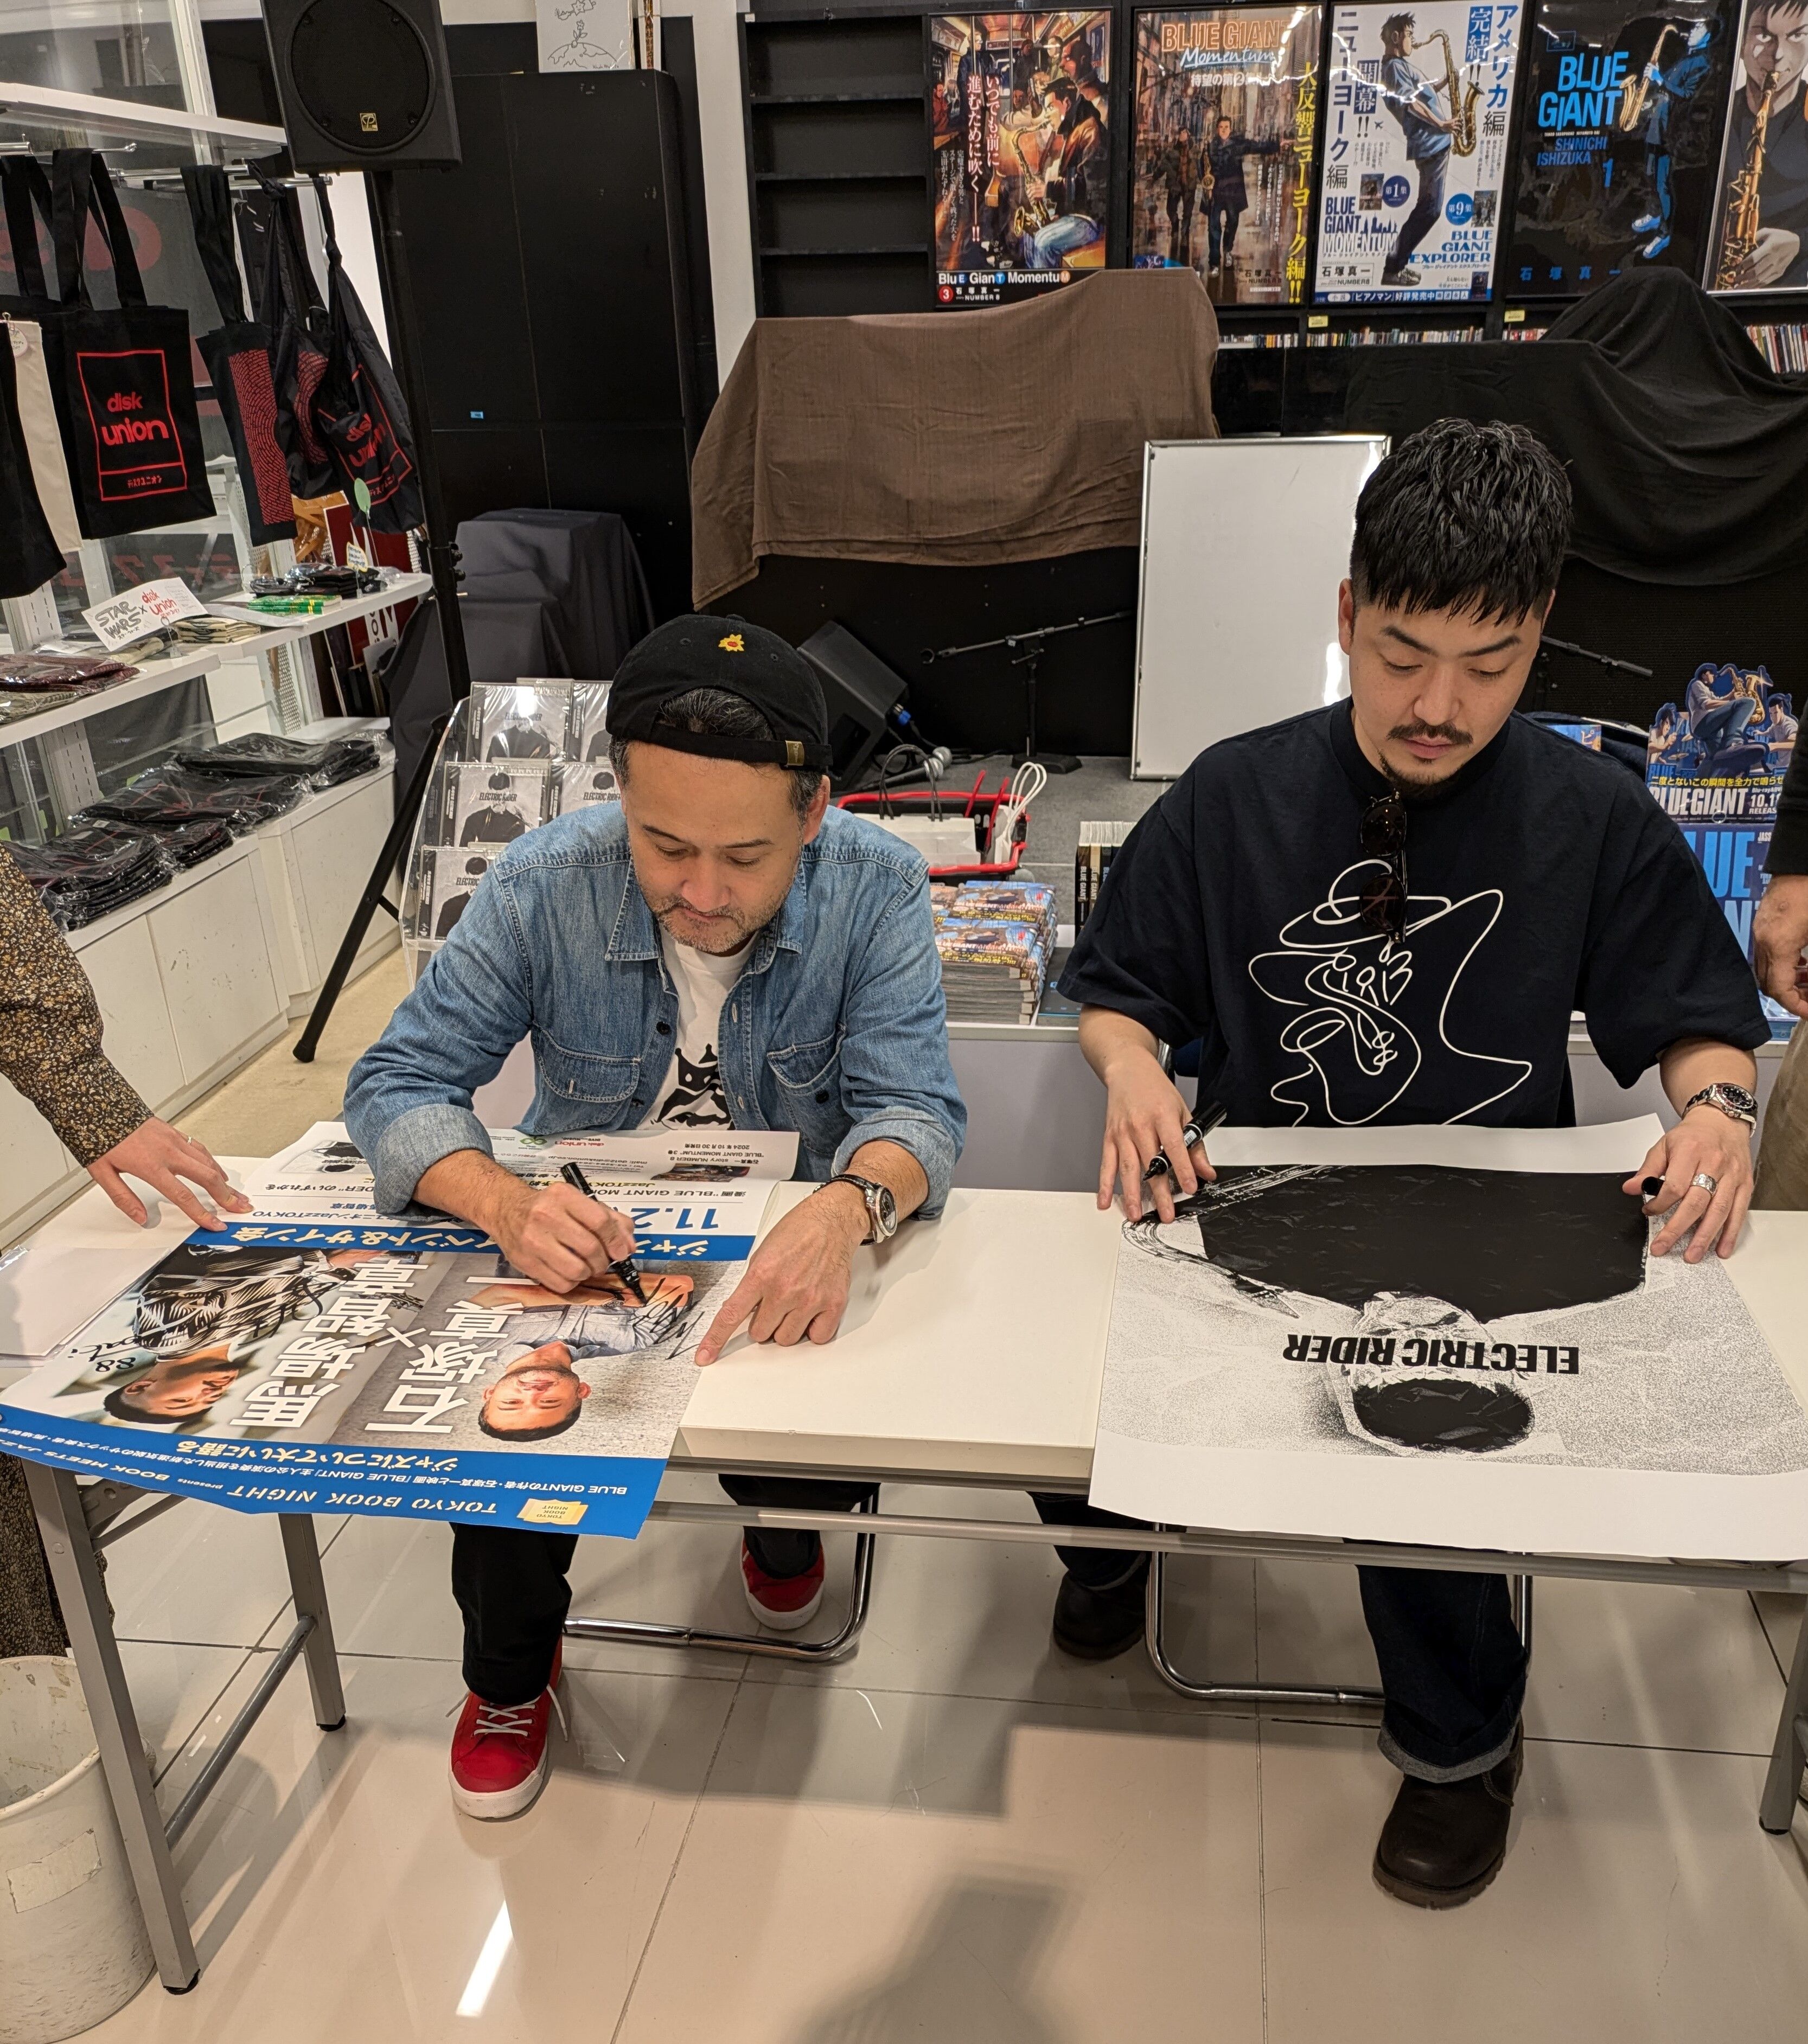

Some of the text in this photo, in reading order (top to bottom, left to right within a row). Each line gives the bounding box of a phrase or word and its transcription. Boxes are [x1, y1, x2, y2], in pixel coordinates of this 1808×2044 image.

[1161, 20, 1292, 52] BLUE GIANT
[1179, 46, 1276, 69] Momentum
[1482, 5, 1519, 137] アメリカ編
[1557, 51, 1629, 92] BLUE
[1326, 11, 1359, 190] ニューヨーク編
[1538, 91, 1622, 131] GIANT
[985, 75, 1000, 168] いつでも前に
[1555, 137, 1608, 151] SHINICHI
[1537, 151, 1592, 166] ISHIZUKA
[1602, 158, 1614, 188] 1
[1325, 196, 1356, 215] BLUE
[1324, 215, 1362, 234] GIANT
[1323, 233, 1398, 254] MOMENTUM
[1451, 230, 1493, 241] BLUE
[1441, 241, 1493, 252] GIANT
[1409, 252, 1491, 264] EXPLORER
[1322, 265, 1370, 277] 石塚真一
[942, 289, 950, 300] 3
[107, 391, 143, 412] disk
[101, 417, 169, 446] union
[142, 589, 160, 604] disk
[95, 601, 137, 627] STAR
[104, 612, 142, 639] WARS
[479, 792, 502, 802] ELECTRIC
[583, 792, 606, 801] ELECTRIC
[265, 1184, 336, 1192] のいずれかを
[229, 1258, 429, 1428] 馬場智章
[364, 1276, 541, 1433] 石塚真一
[1282, 1332, 1580, 1375] ELECTRIC RIDER
[43, 1451, 109, 1469] MEETS
[176, 1440, 459, 1472] ジャズについて大いに語る
[110, 1464, 170, 1482] BOOK
[177, 1478, 224, 1490] presents
[587, 1485, 628, 1495] BLUE
[226, 1485, 317, 1503] NIGHT
[324, 1492, 403, 1508] BOOK
[411, 1498, 497, 1514] TOKYO
